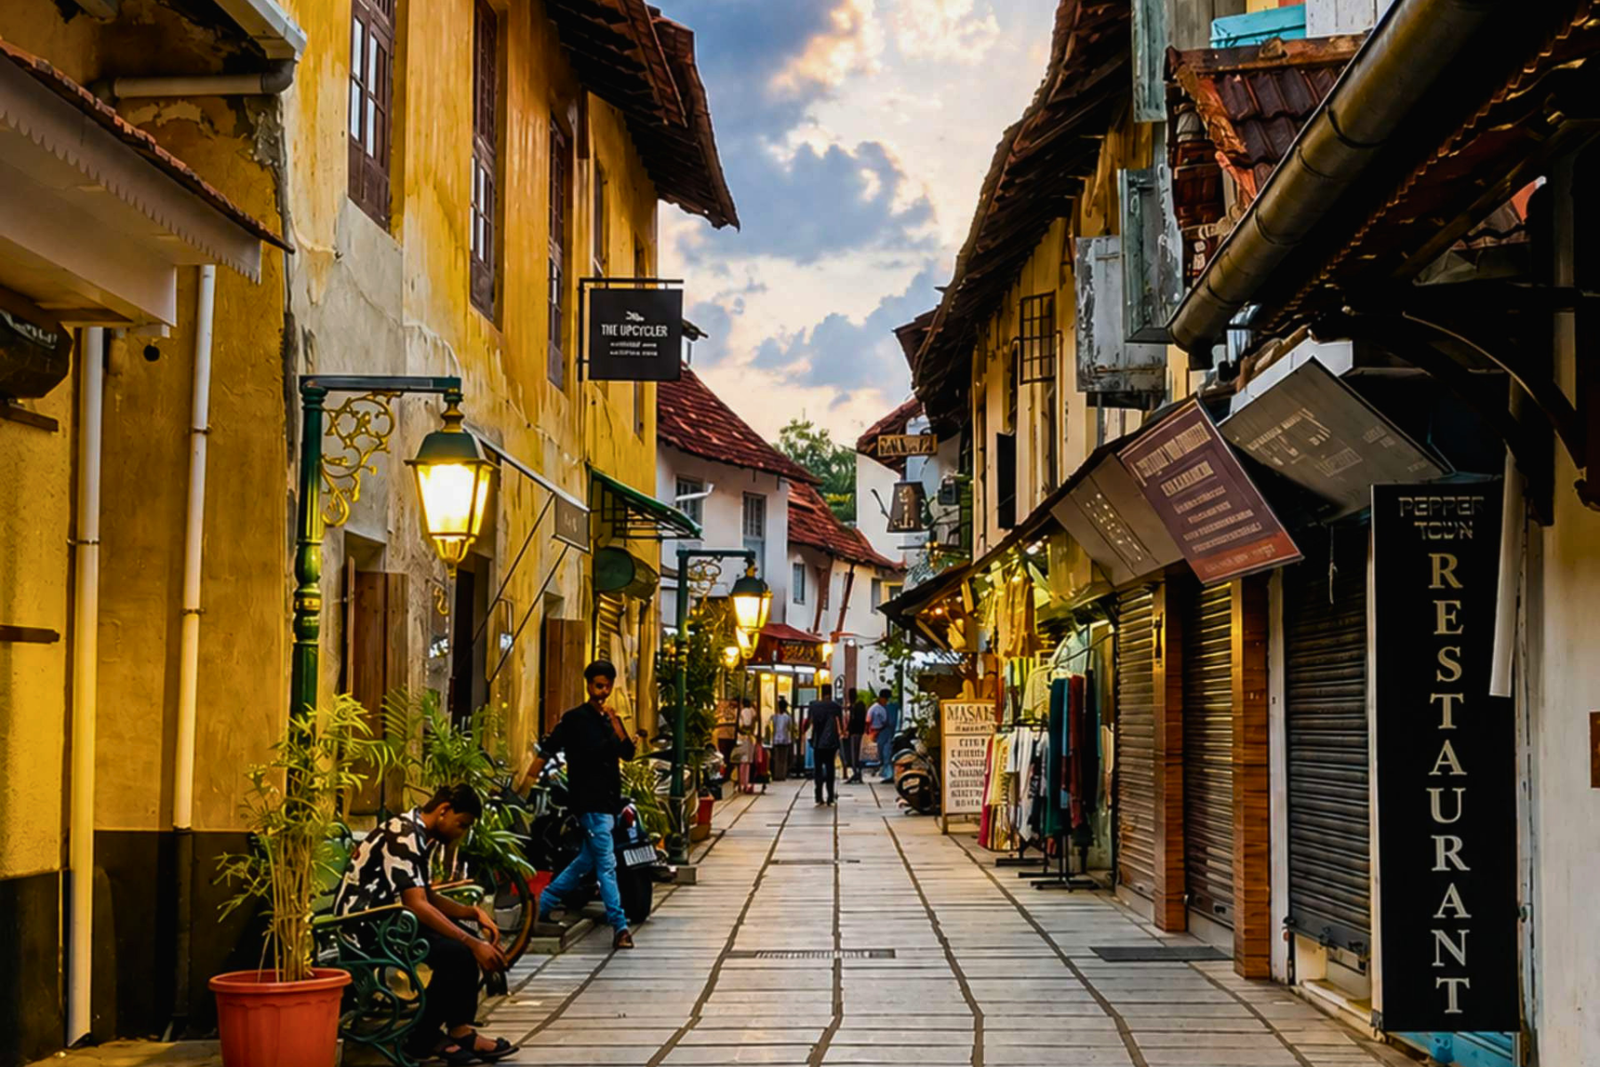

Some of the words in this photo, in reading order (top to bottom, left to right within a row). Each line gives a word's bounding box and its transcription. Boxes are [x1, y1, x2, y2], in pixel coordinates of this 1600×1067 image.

[601, 324, 618, 336] THE
[620, 325, 668, 337] UPCYCLER
[1398, 496, 1484, 517] PEPPER
[1426, 553, 1471, 1013] RESTAURANT
